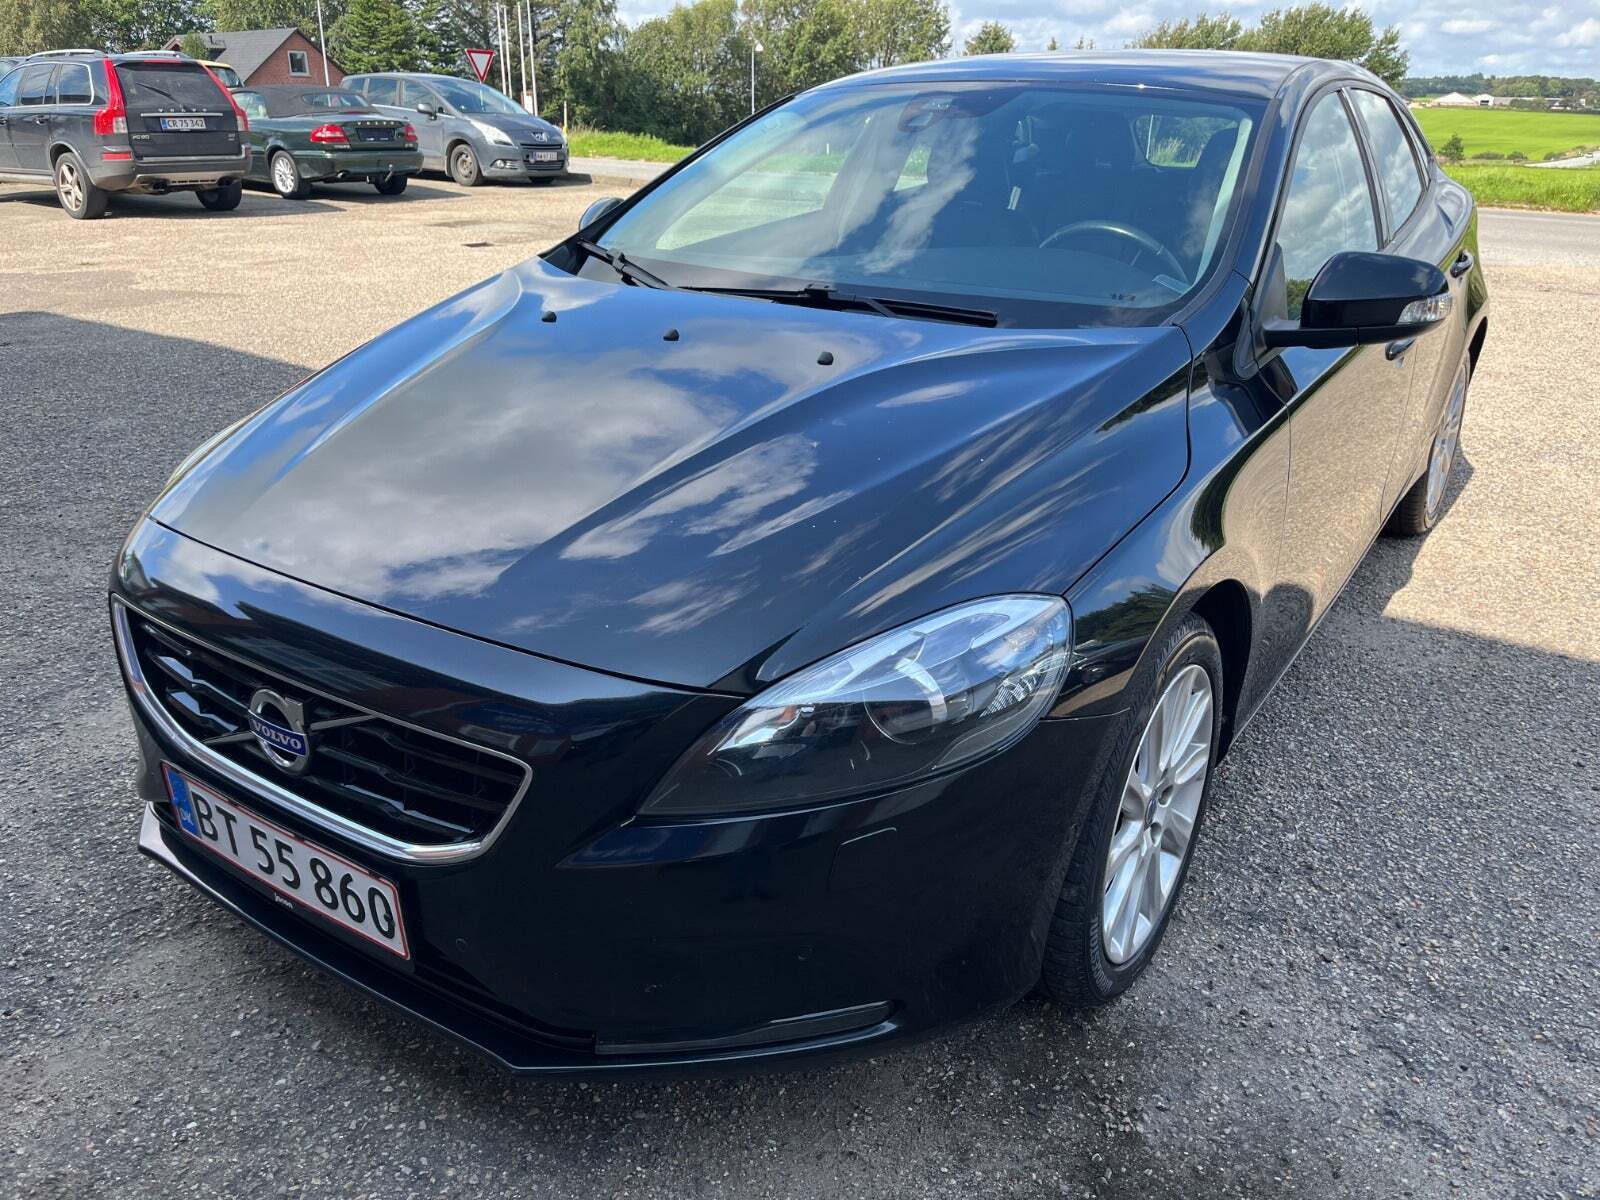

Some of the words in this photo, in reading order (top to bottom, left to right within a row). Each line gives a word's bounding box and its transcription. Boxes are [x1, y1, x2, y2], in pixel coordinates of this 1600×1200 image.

[167, 119, 178, 128] CR
[179, 119, 189, 128] 75
[190, 119, 204, 129] 342
[251, 718, 302, 750] VOLVO
[191, 789, 239, 857] BT
[249, 824, 301, 890] 55
[309, 857, 396, 940] 860
